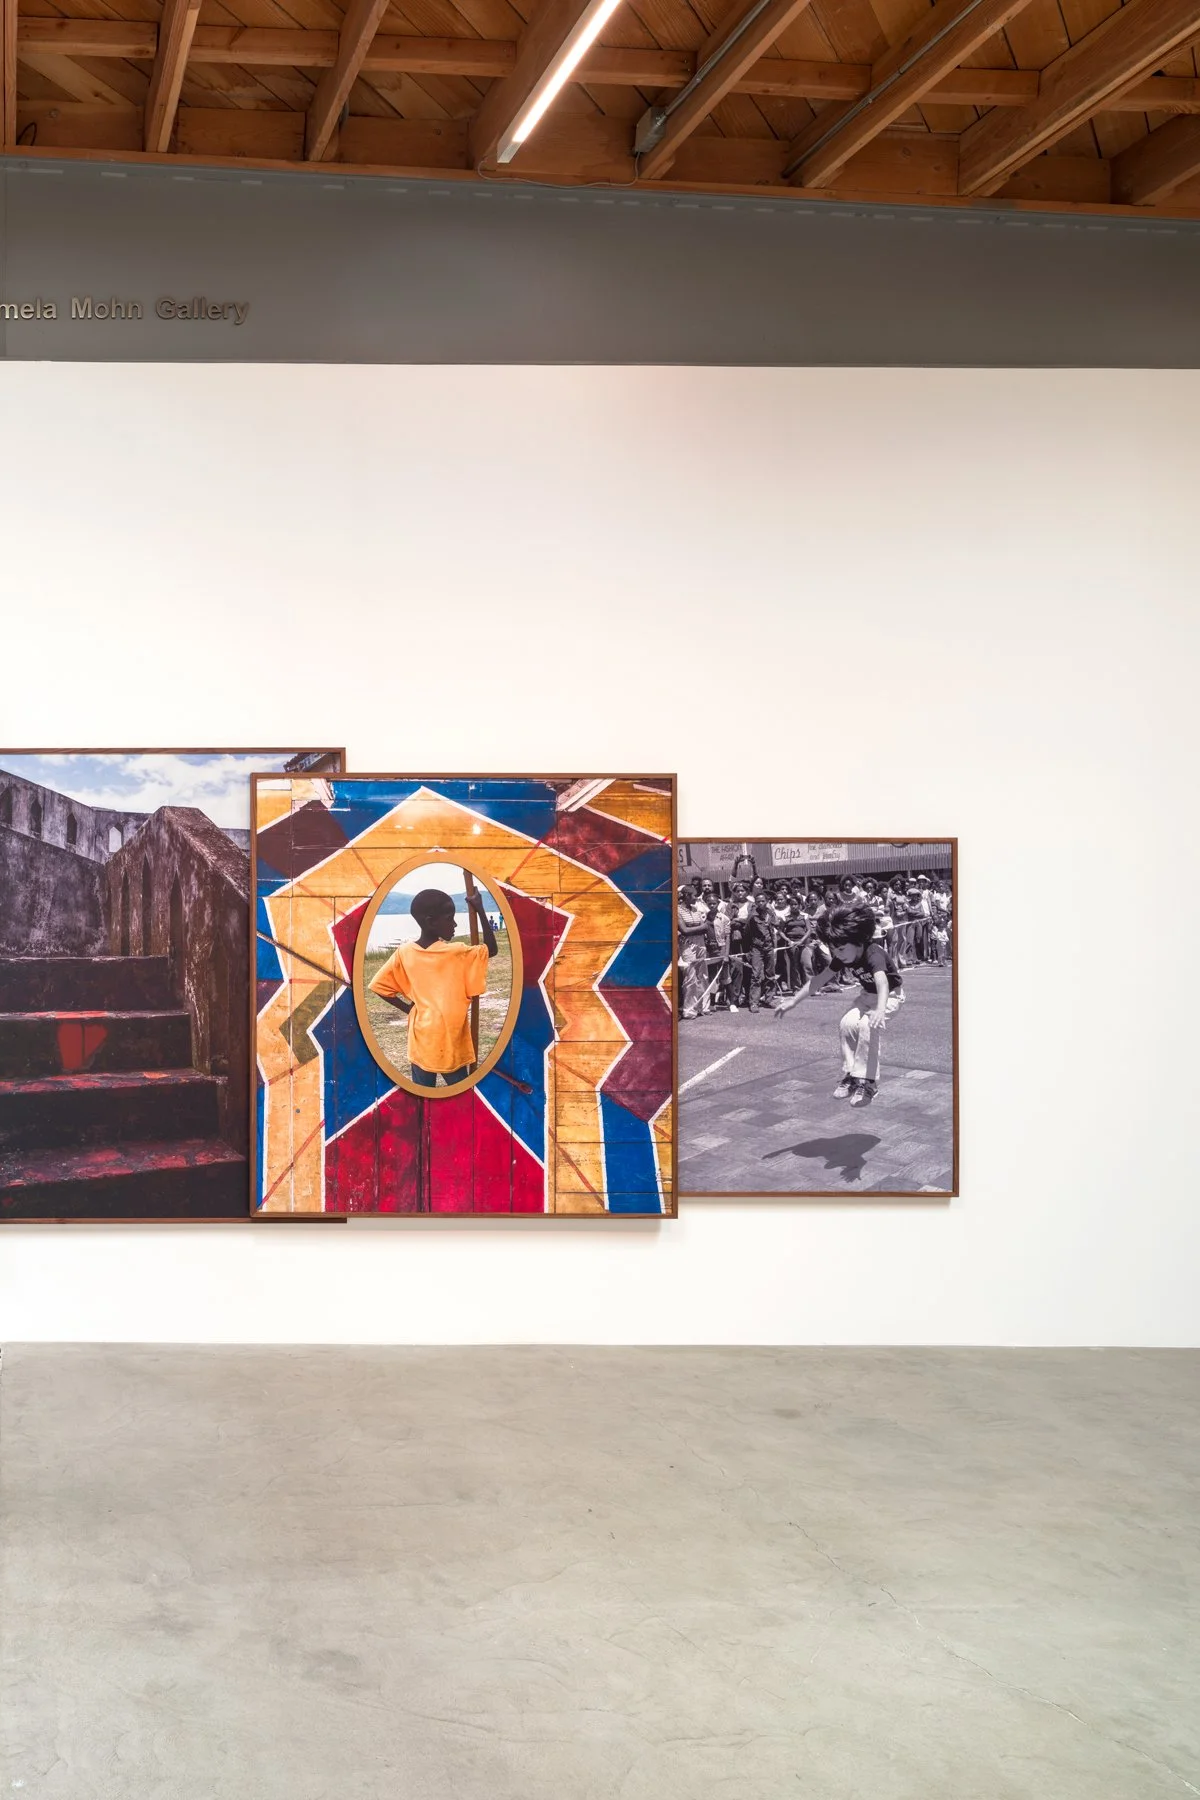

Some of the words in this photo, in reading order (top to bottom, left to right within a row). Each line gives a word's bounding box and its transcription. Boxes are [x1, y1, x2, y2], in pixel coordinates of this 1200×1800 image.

[70, 298, 144, 320] Mohn
[155, 298, 250, 325] Gallery
[774, 846, 802, 864] Chips
